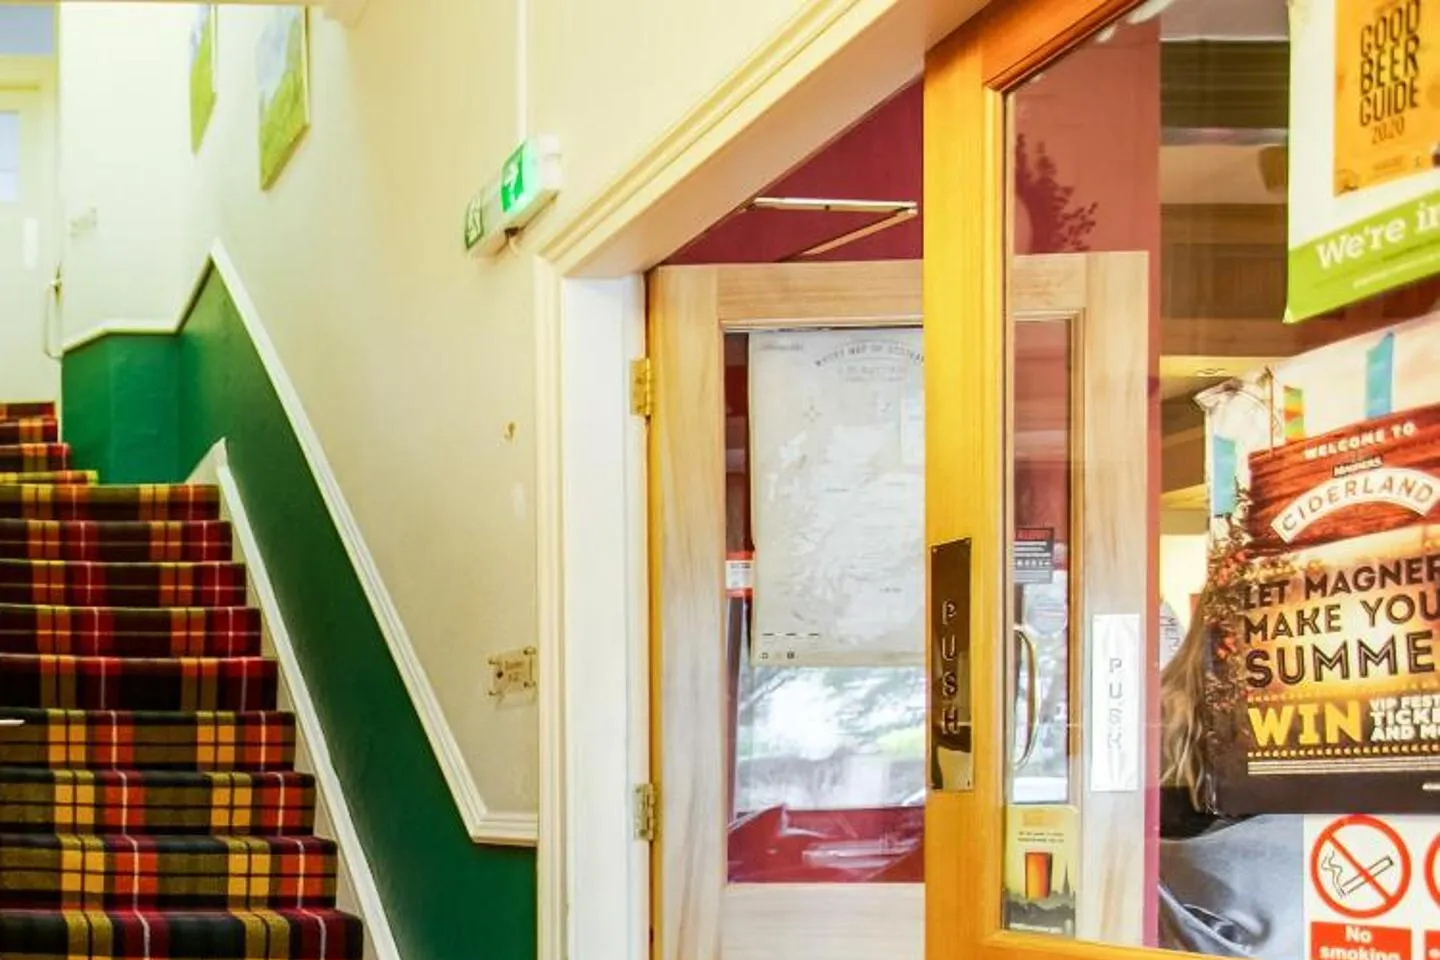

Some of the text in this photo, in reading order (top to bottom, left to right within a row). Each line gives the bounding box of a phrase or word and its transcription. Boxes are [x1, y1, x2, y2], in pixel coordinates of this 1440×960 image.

[1360, 0, 1420, 58] GOOD
[1360, 34, 1420, 96] BEER
[1360, 77, 1420, 128] GUIDE
[1371, 116, 1405, 145] 2020
[1315, 217, 1407, 270] We're
[1304, 420, 1416, 460] WELCOME TO
[1281, 475, 1435, 533] CIDERLAND
[1243, 580, 1292, 611] LET
[1244, 588, 1440, 644] MAKE YOU
[941, 599, 960, 736] PUSH
[1245, 629, 1436, 689] SUMME
[1247, 698, 1363, 748] WIN
[1369, 697, 1399, 713] VIP
[1370, 724, 1416, 742] AND
[1345, 924, 1373, 944] No
